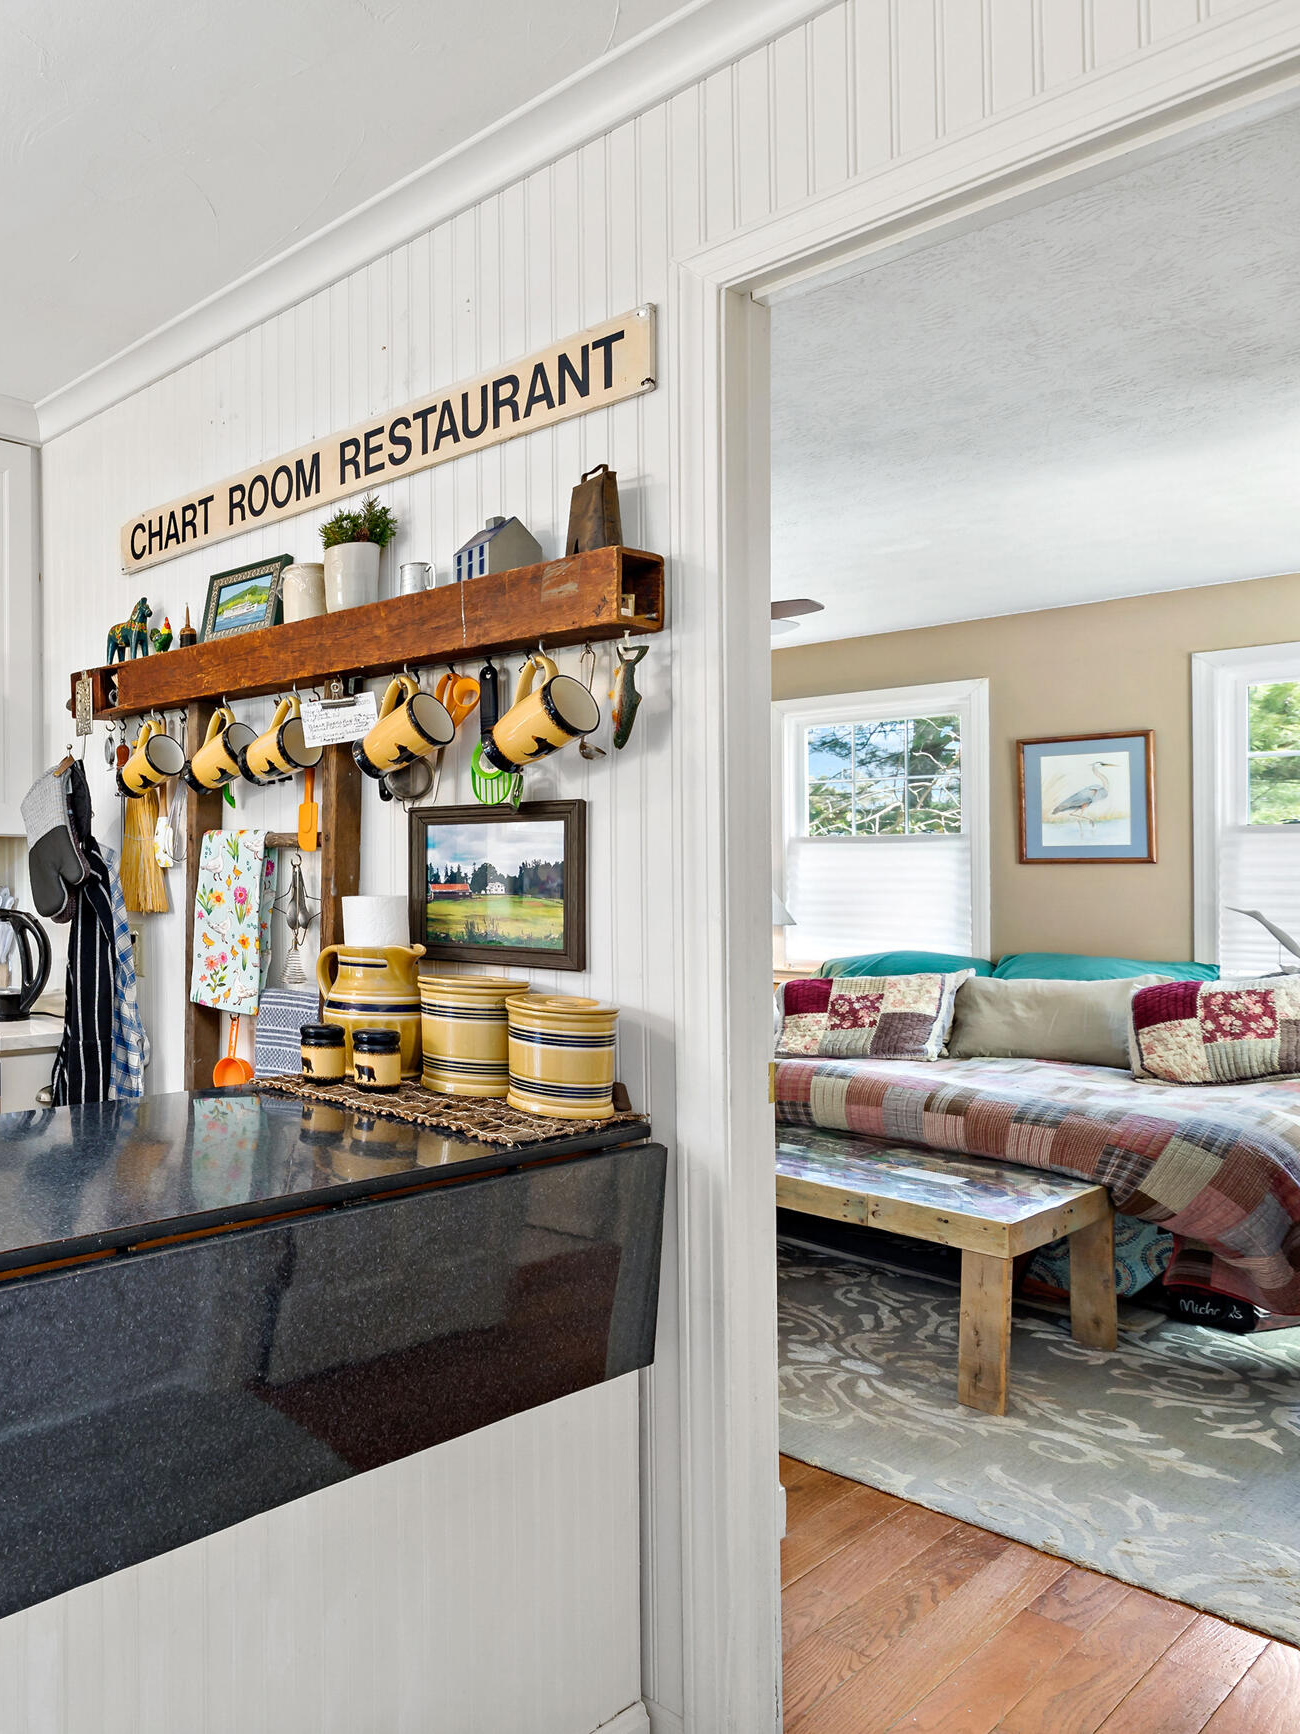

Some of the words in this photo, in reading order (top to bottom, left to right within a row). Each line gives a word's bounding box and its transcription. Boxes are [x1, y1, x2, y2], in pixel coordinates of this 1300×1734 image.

[130, 494, 215, 561] CHART
[228, 451, 321, 527] ROOM
[339, 329, 625, 486] RESTAURANT
